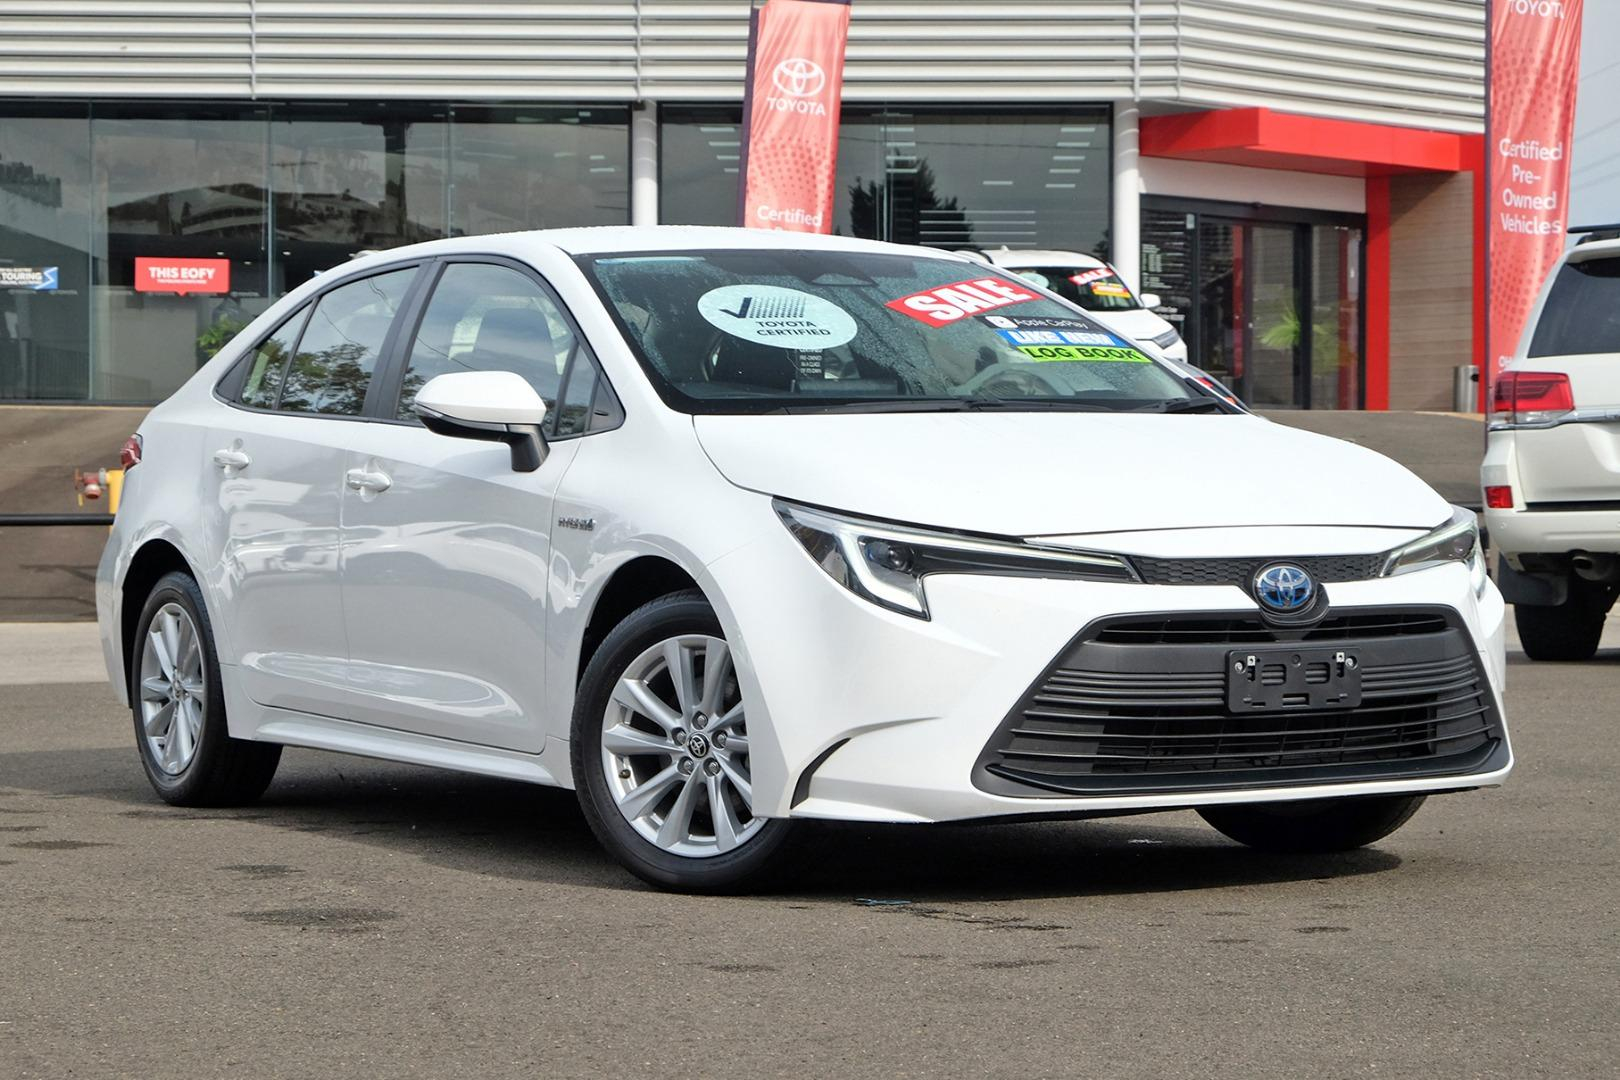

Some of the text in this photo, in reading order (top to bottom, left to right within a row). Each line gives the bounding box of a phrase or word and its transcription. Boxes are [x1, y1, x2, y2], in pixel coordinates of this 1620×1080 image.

[767, 97, 826, 116] TOYOTA
[1499, 138, 1563, 160] Certified
[1512, 164, 1541, 184] Pre-
[1503, 188, 1557, 210] Owned
[757, 205, 824, 227] Certified
[1500, 212, 1563, 235] Vehicles
[148, 266, 216, 280] THIS EOFY
[903, 279, 1033, 321] SALE
[1024, 346, 1141, 360] LOG BOOK
